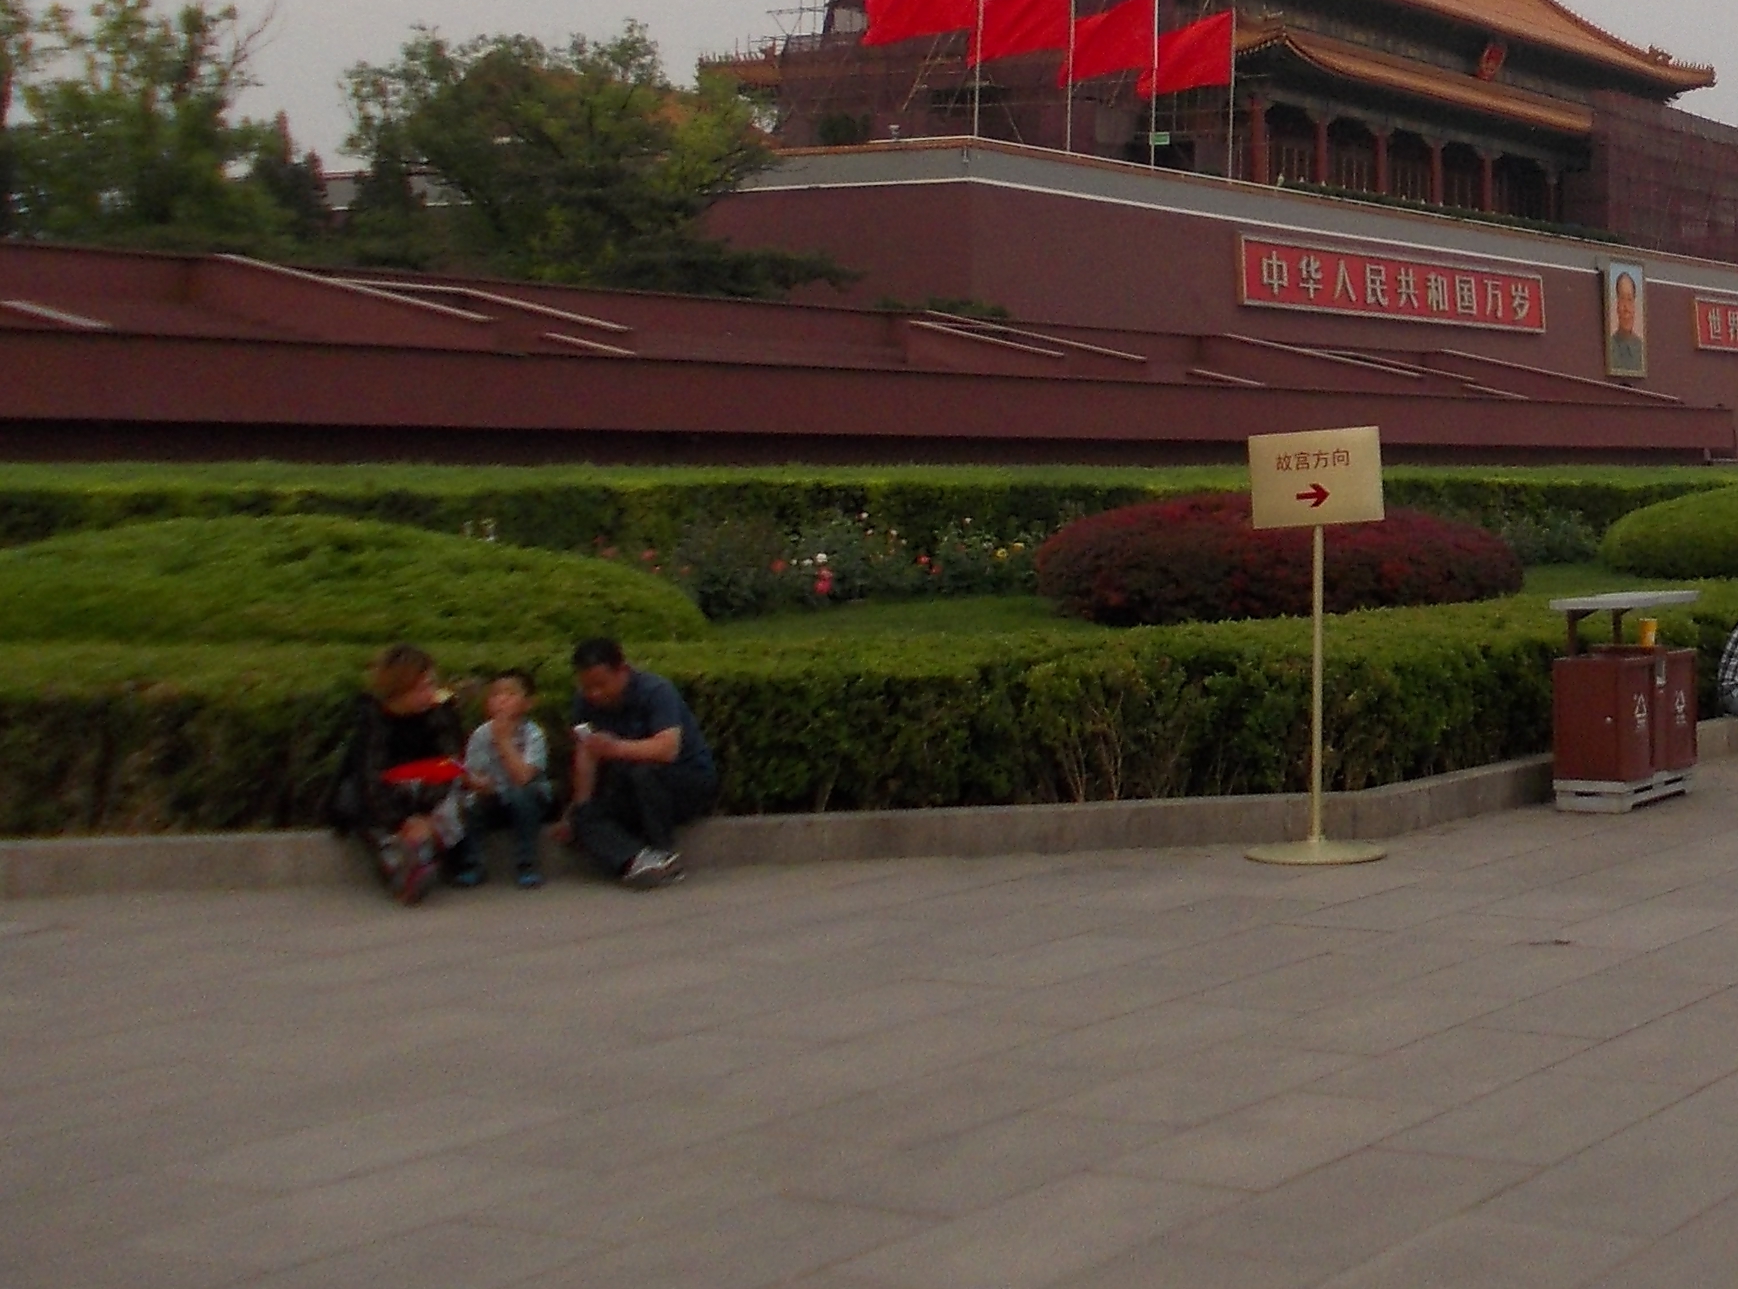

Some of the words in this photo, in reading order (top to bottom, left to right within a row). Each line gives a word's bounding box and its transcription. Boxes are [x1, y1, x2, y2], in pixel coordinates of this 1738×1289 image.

[1261, 250, 1530, 321] 中华人民共和国万岁
[1276, 448, 1350, 471] 故宫方向
